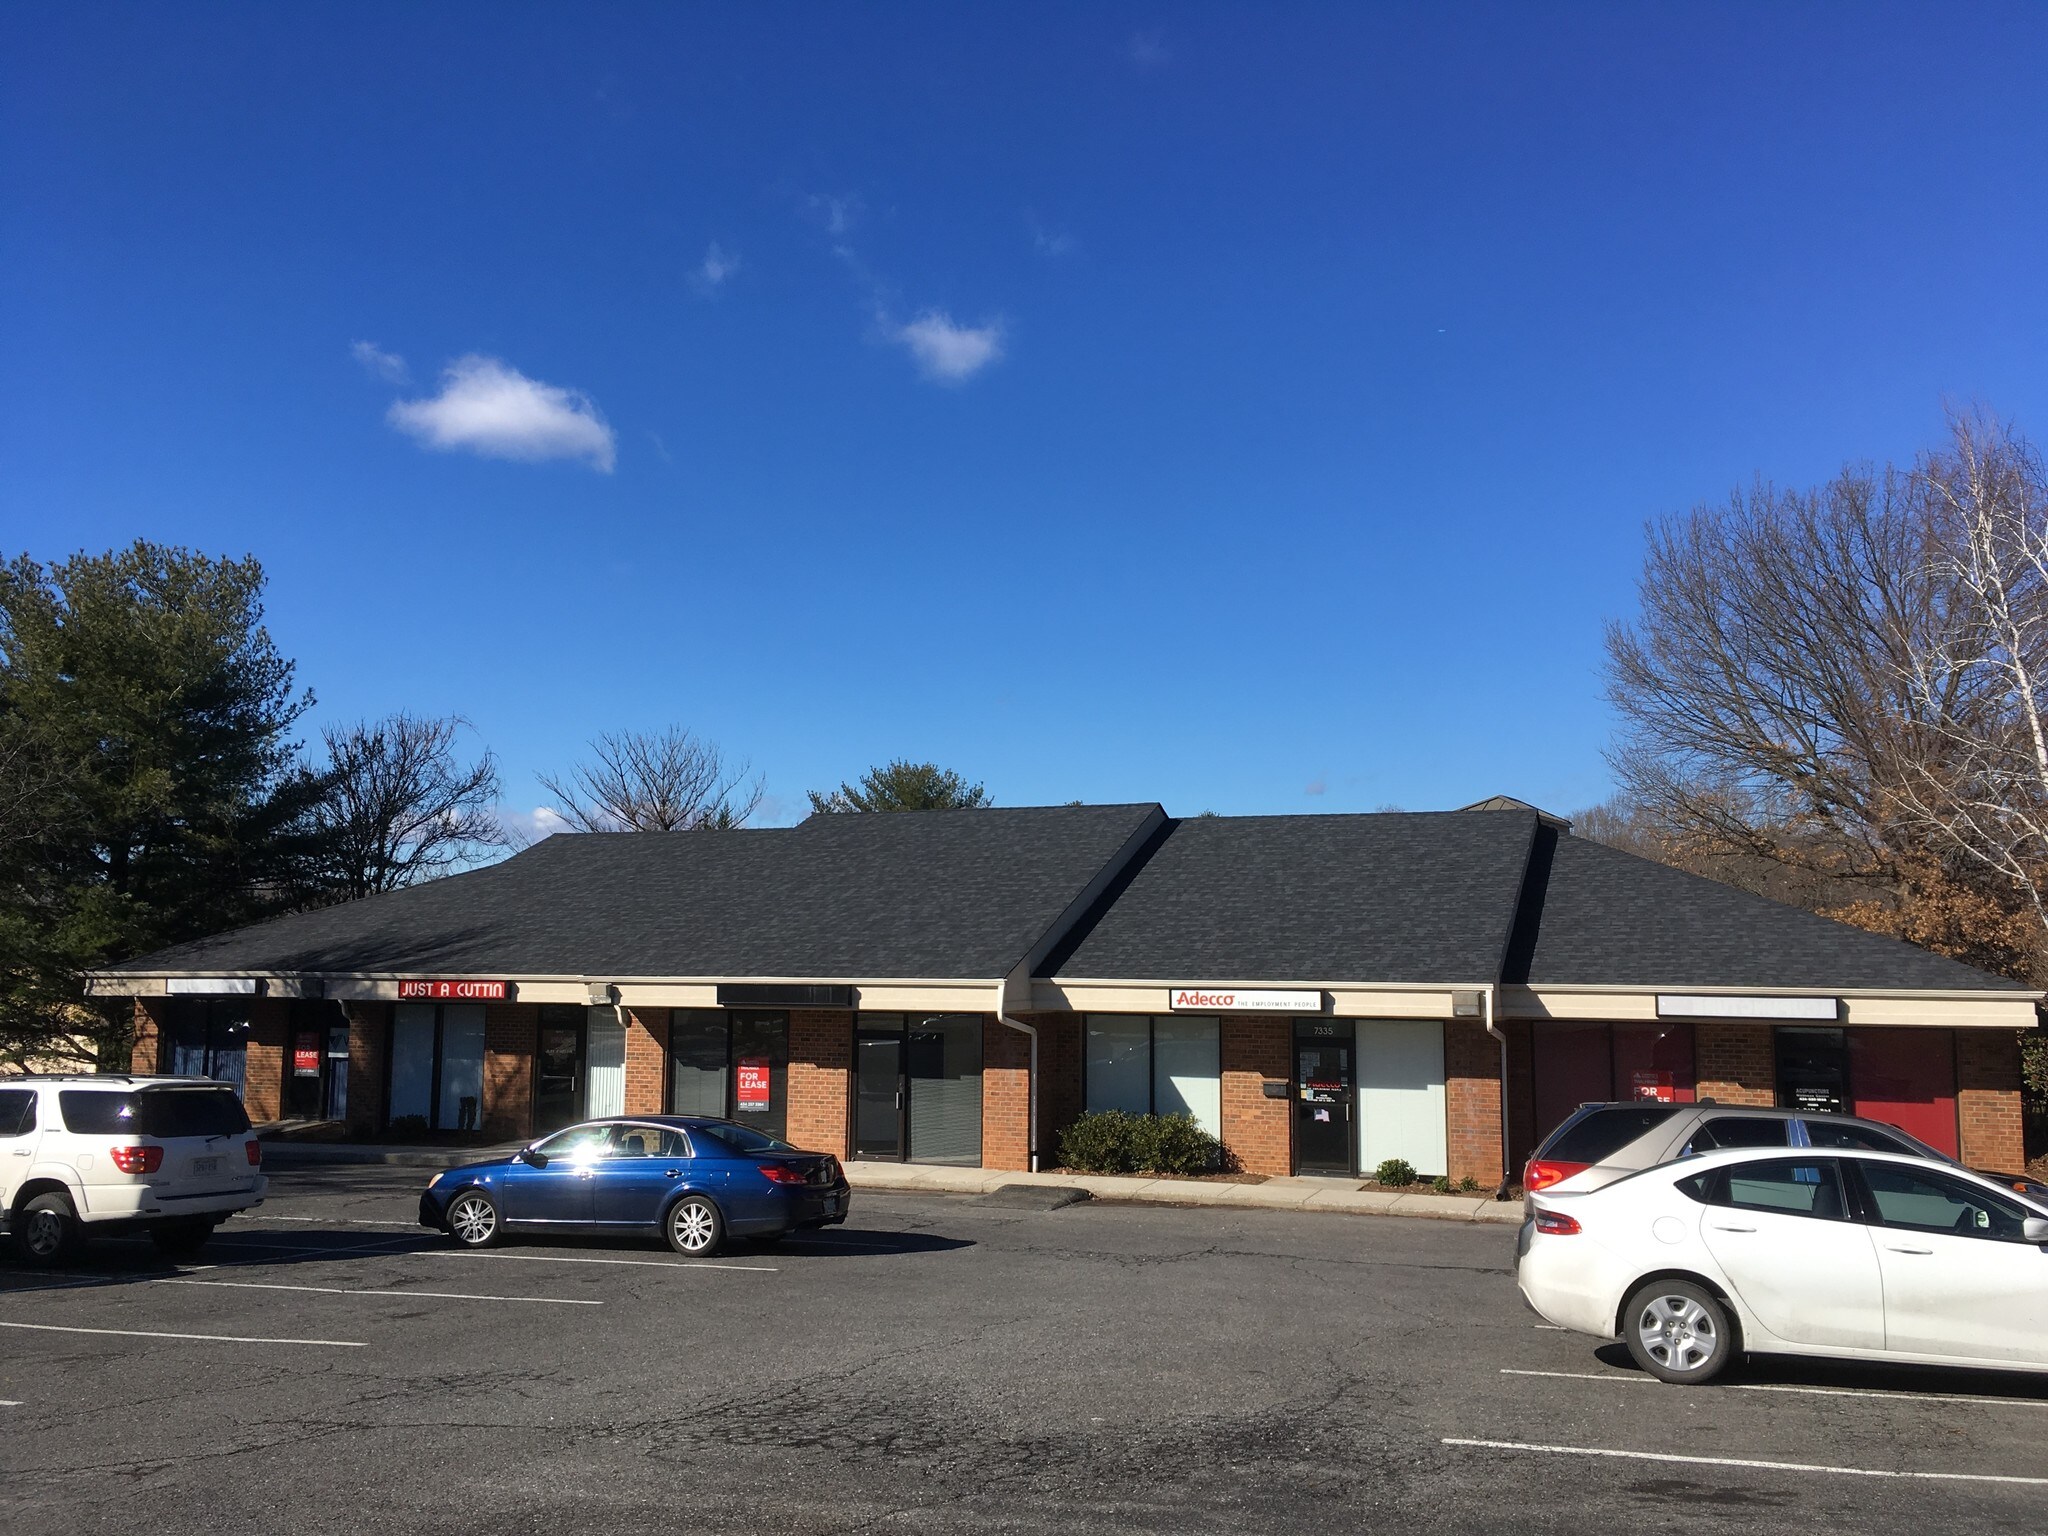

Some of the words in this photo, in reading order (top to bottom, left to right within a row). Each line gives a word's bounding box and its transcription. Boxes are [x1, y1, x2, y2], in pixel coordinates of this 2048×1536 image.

[402, 982, 434, 996] JUST
[440, 982, 450, 997] A
[457, 982, 502, 997] CUTTIN
[1176, 991, 1235, 1006] Adecco
[1314, 1027, 1333, 1035] 7335
[740, 1072, 758, 1080] FOR
[740, 1081, 767, 1089] LEASE
[1633, 1086, 1658, 1096] FOR
